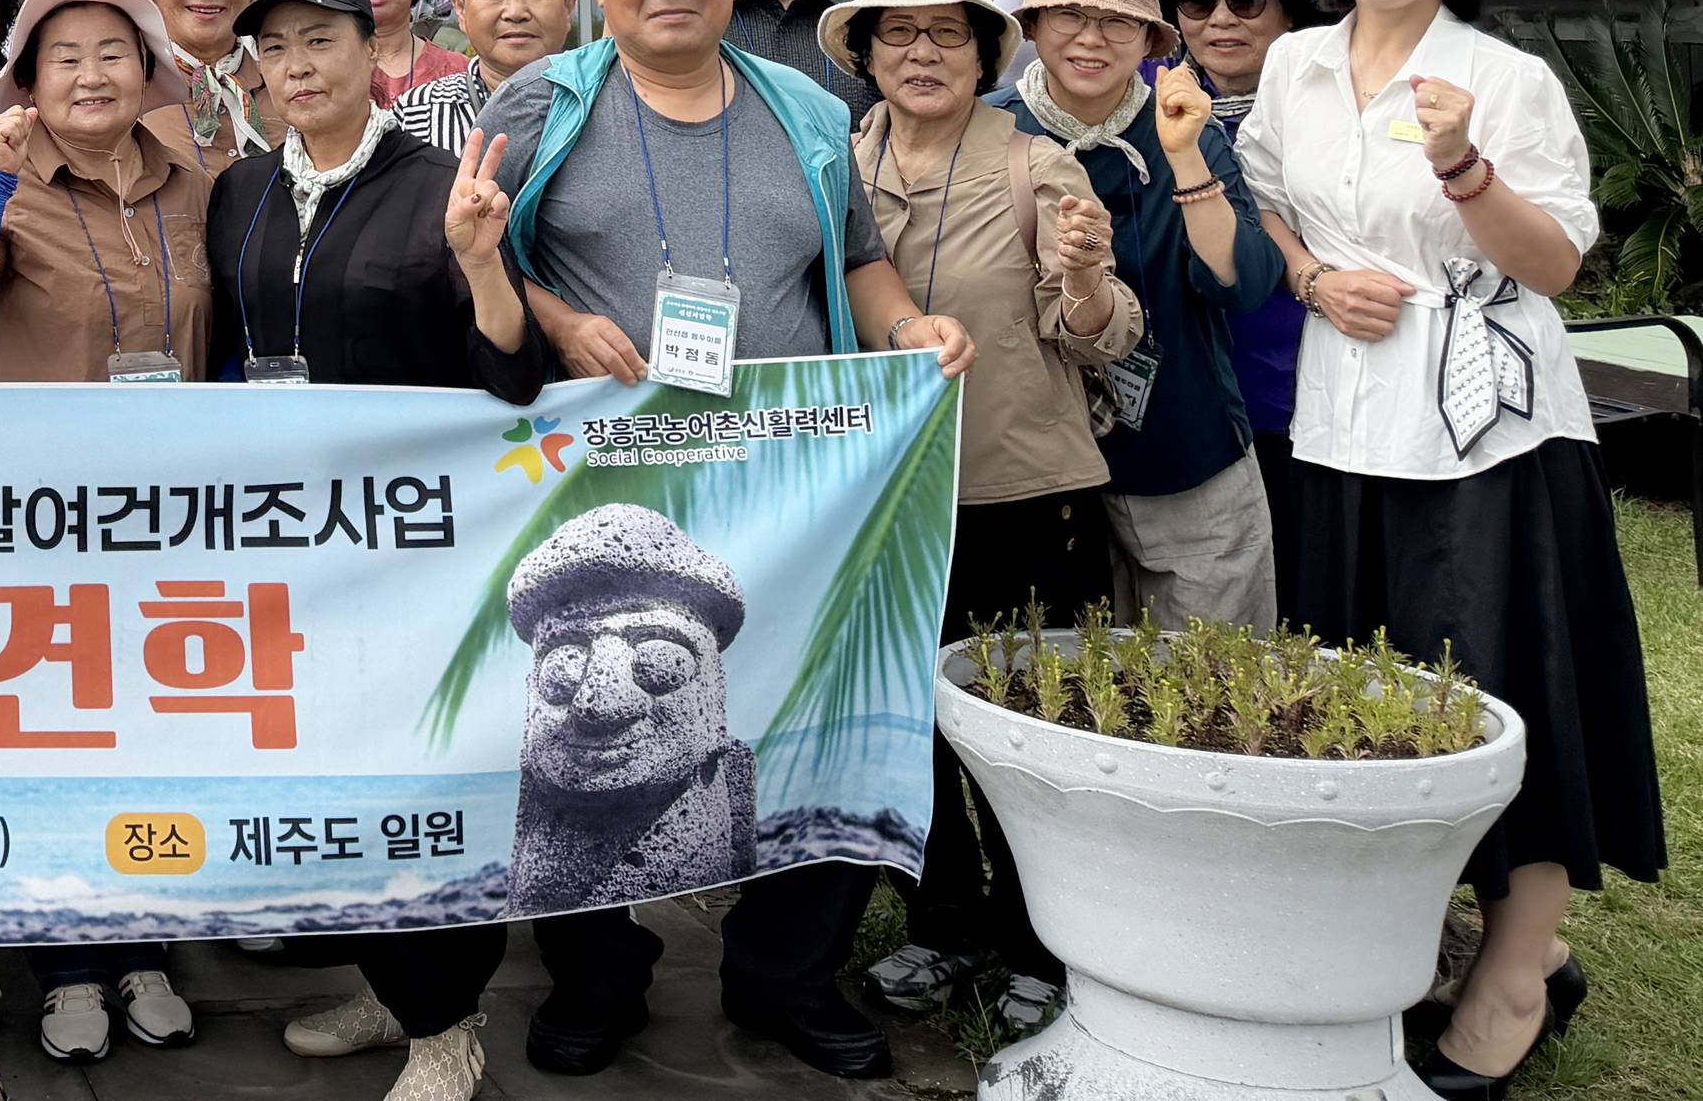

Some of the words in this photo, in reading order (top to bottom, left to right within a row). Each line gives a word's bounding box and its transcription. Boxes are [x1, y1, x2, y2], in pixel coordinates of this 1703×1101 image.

[583, 404, 872, 446] 장흥군농어촌신활력센터
[588, 451, 636, 465] Social
[643, 445, 746, 465] Cooperative
[124, 823, 191, 862] 장소
[229, 816, 363, 866] 제주도
[380, 810, 465, 861] 일원
